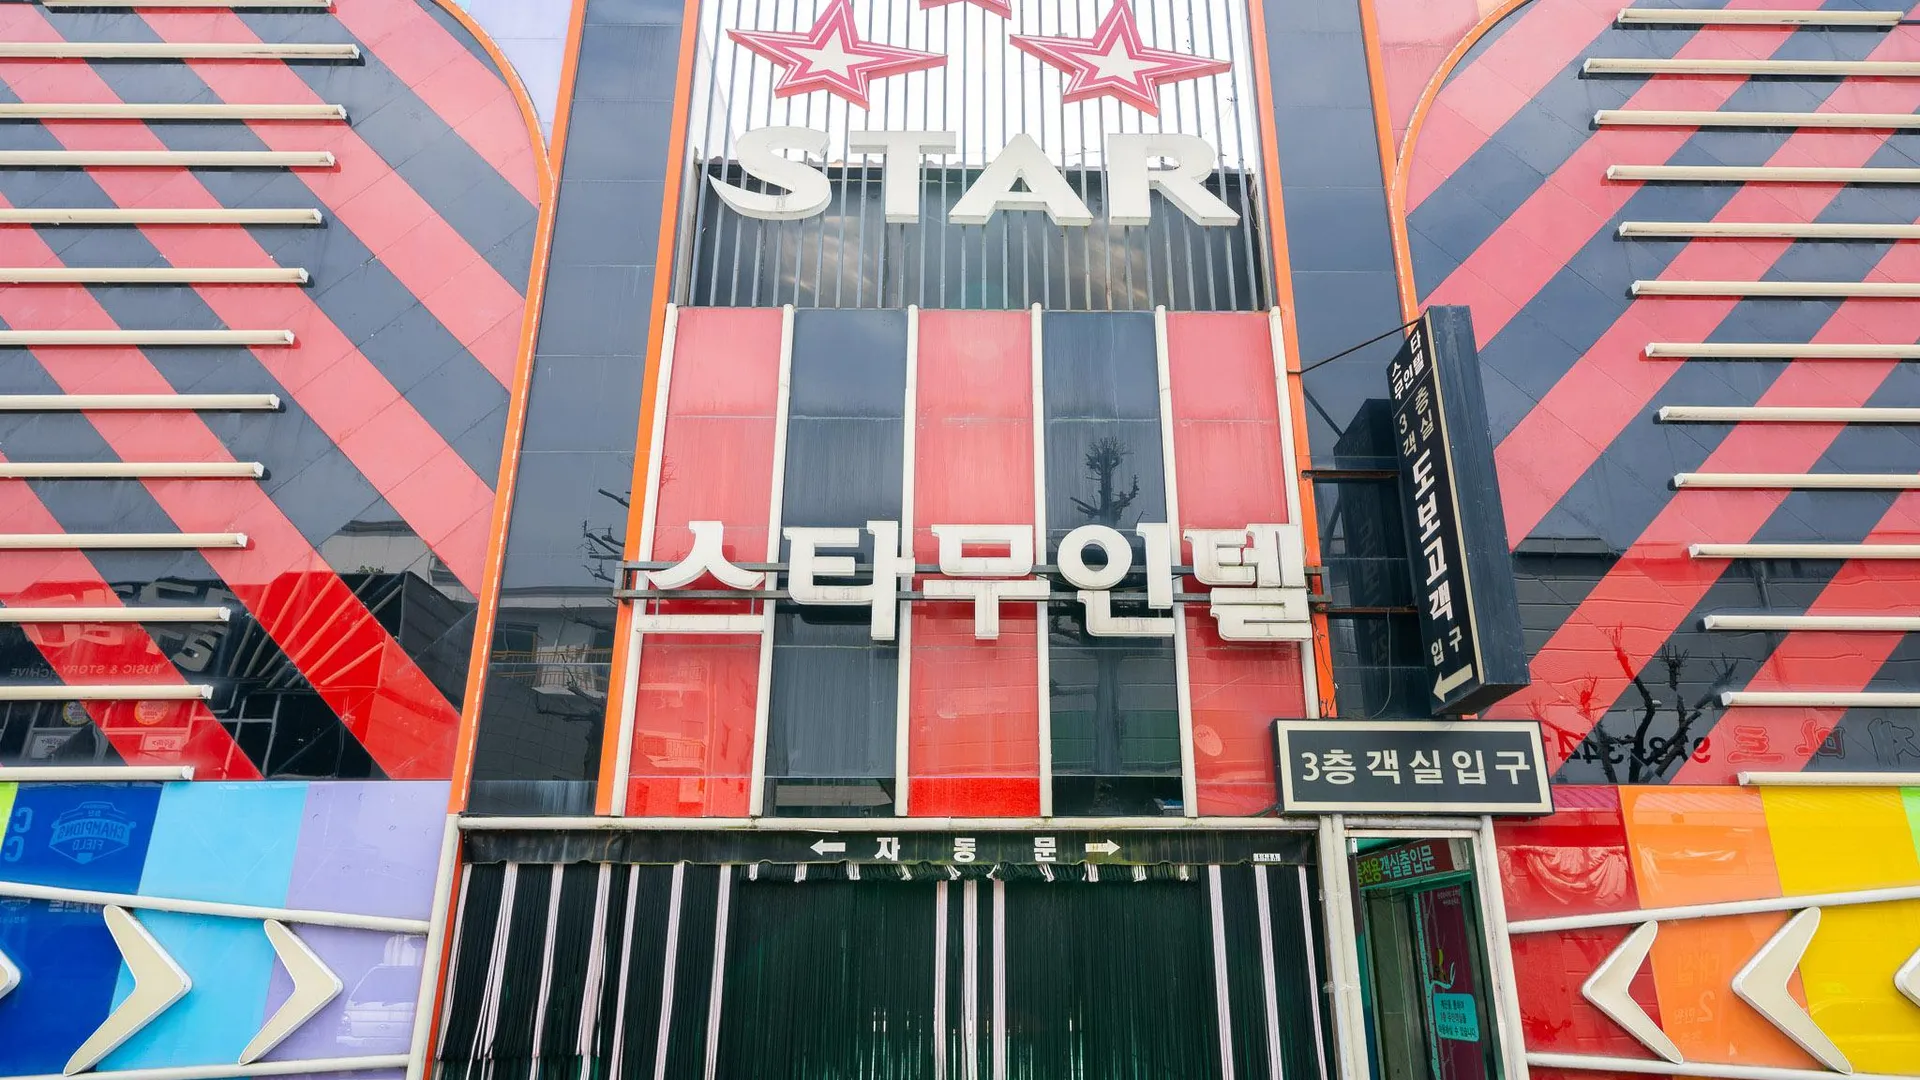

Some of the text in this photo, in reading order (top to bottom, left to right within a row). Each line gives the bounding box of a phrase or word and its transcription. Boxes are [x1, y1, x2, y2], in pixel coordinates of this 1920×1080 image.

[708, 125, 1240, 227] STAR
[636, 520, 1312, 643] 스타무인텔
[1412, 448, 1453, 621] 도보고객
